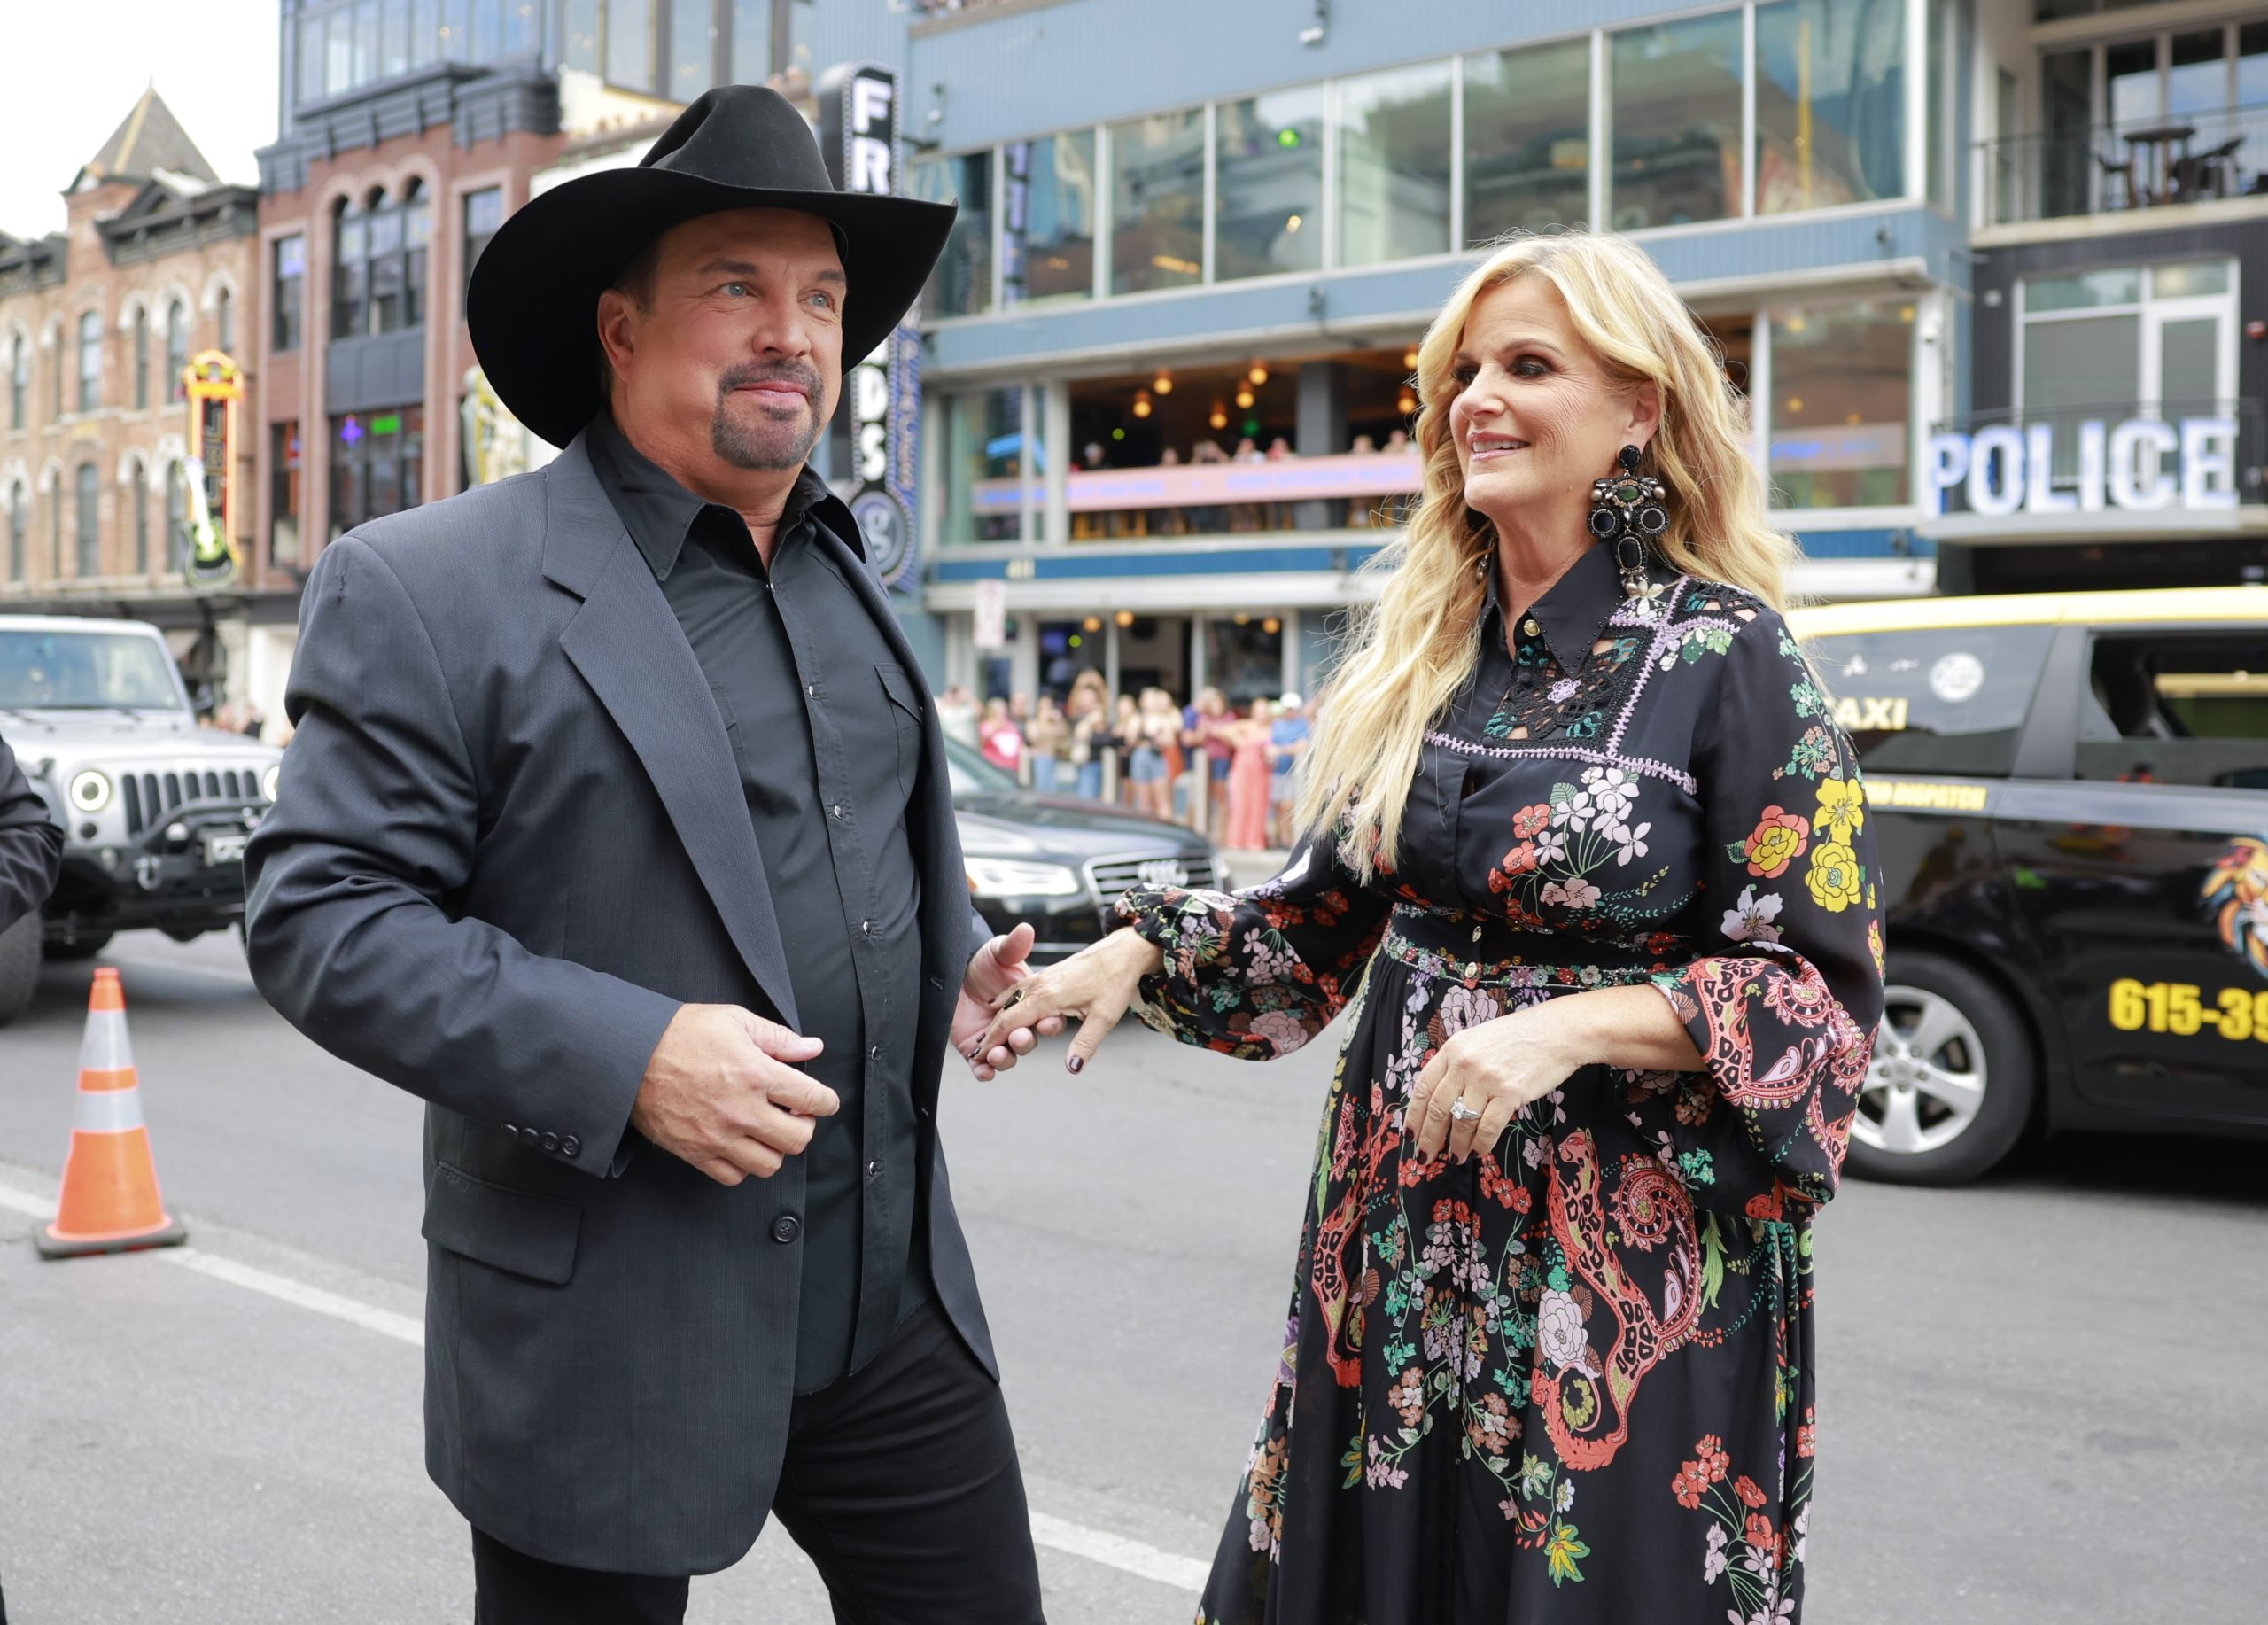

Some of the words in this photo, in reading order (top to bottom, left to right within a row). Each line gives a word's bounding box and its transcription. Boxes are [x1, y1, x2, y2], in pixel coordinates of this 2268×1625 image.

[851, 76, 892, 482] FRDS
[1930, 418, 2241, 519] POLICE
[1827, 696, 1909, 730] AXI
